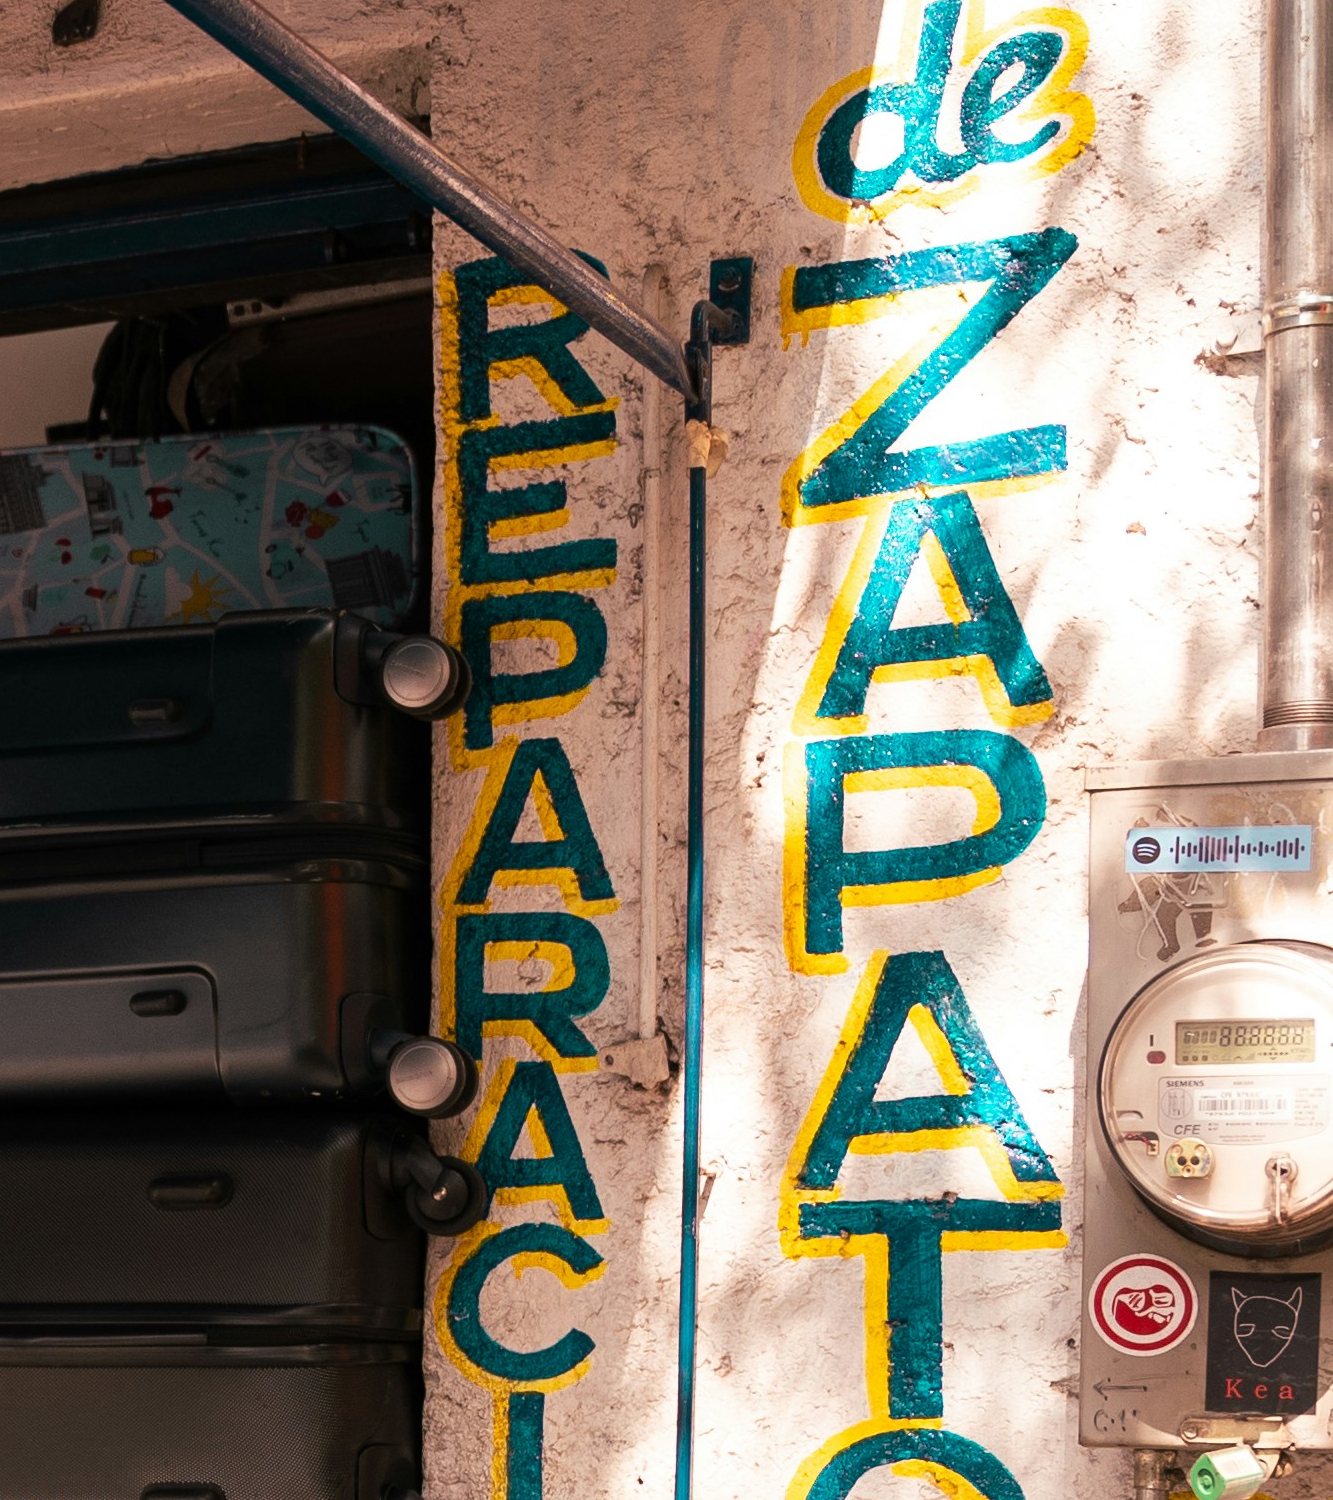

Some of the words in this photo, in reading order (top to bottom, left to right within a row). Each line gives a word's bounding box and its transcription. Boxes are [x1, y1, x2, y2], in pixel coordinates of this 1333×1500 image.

[1165, 1080, 1205, 1088] SIEMENS
[1173, 1124, 1202, 1136] CFE
[1225, 1378, 1294, 1400] Kea
